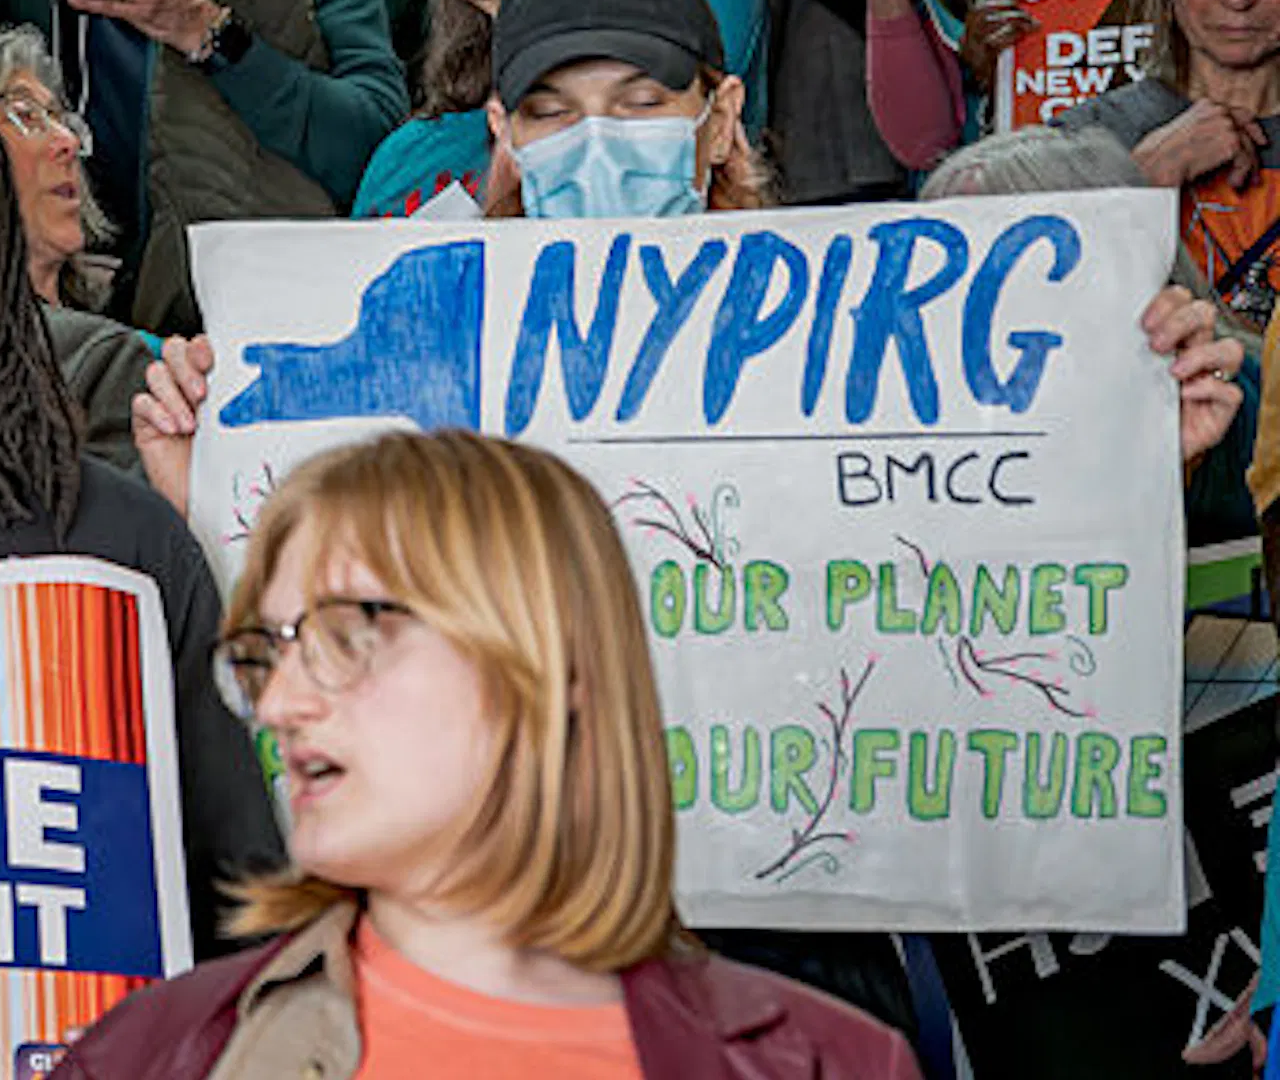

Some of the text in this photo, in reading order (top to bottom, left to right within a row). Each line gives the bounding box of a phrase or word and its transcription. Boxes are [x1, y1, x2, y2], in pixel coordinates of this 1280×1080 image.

[1015, 66, 1115, 96] NEW
[504, 213, 1083, 439] NYPIRG
[836, 449, 1034, 508] BMCC
[650, 559, 1130, 640] OUR PLANET
[669, 726, 822, 821] OUR
[849, 727, 1170, 823] FUTURE
